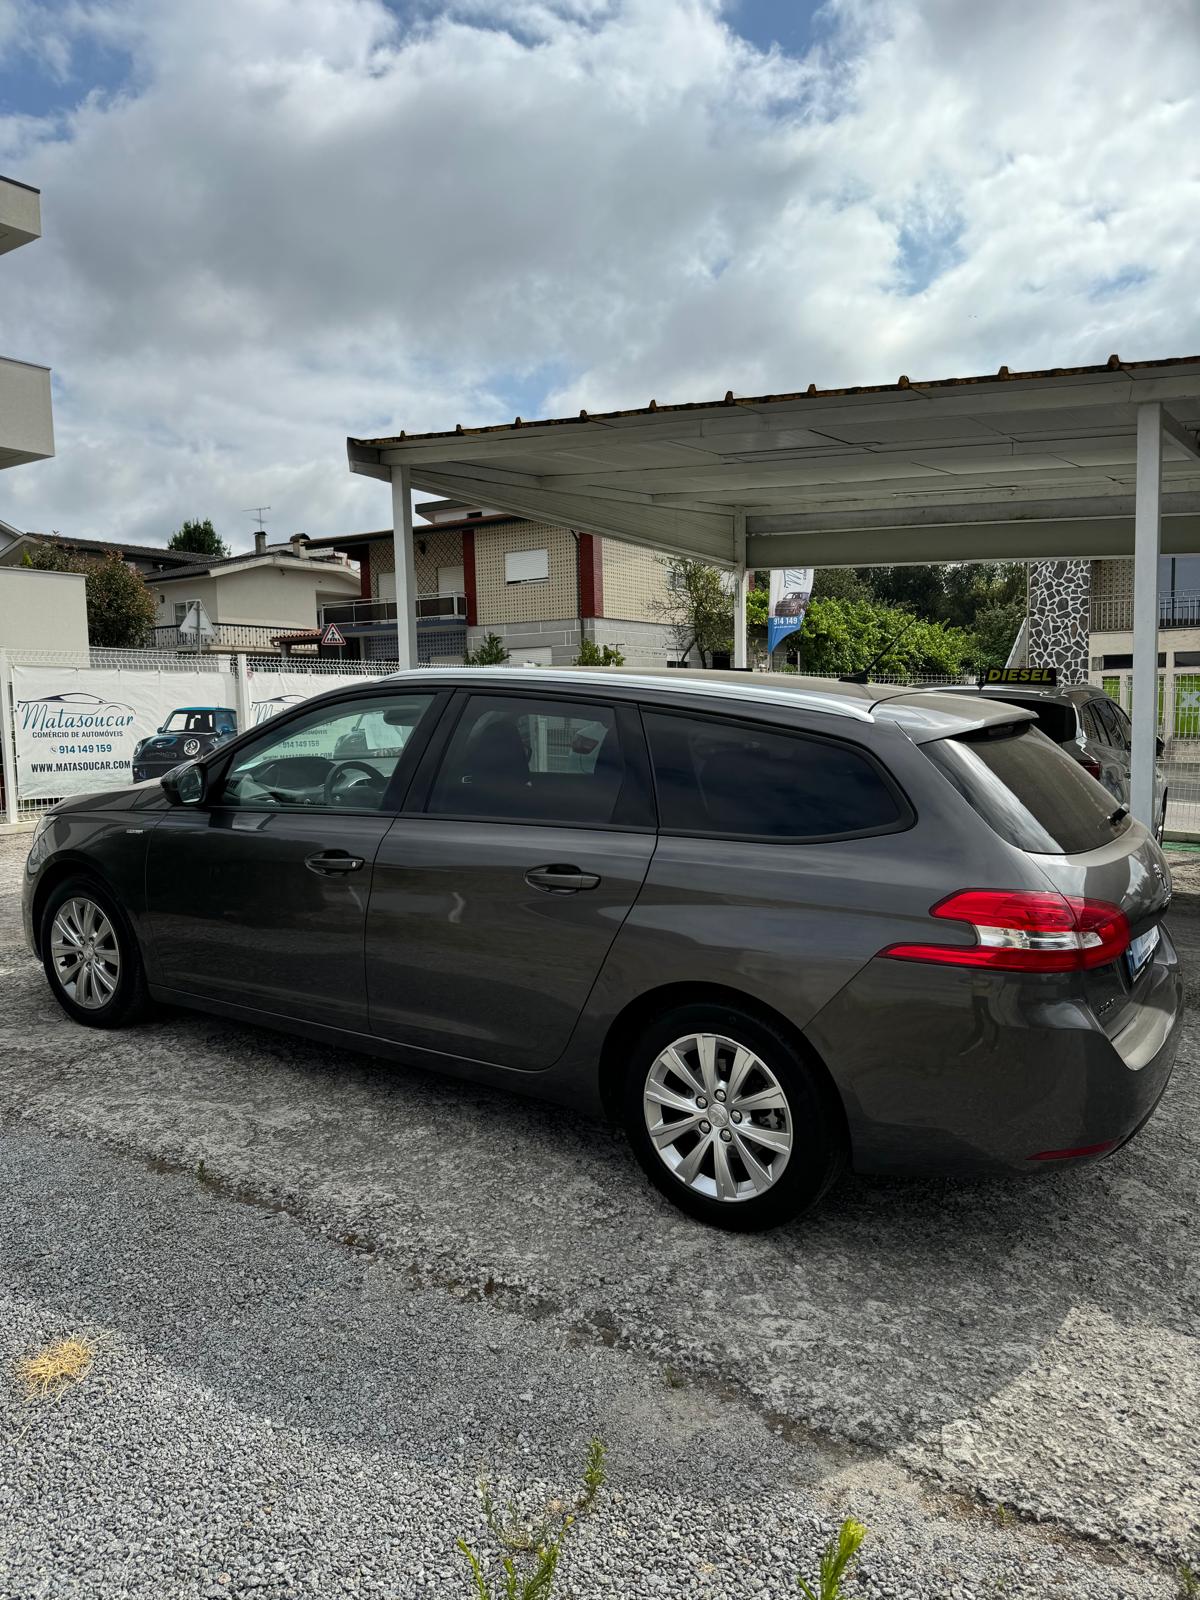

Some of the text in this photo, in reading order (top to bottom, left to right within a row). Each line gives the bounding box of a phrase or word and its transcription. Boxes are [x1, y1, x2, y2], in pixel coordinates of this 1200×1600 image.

[773, 617, 784, 625] 914
[988, 669, 1052, 681] DIESEL
[21, 703, 134, 731] Matasoucar
[32, 730, 69, 738] COMÉRCIO
[81, 729, 123, 737] AUTOMÓVEIS
[58, 744, 112, 754] 914 149 159
[31, 760, 131, 773] WWW.MATASOUCAR.COM
